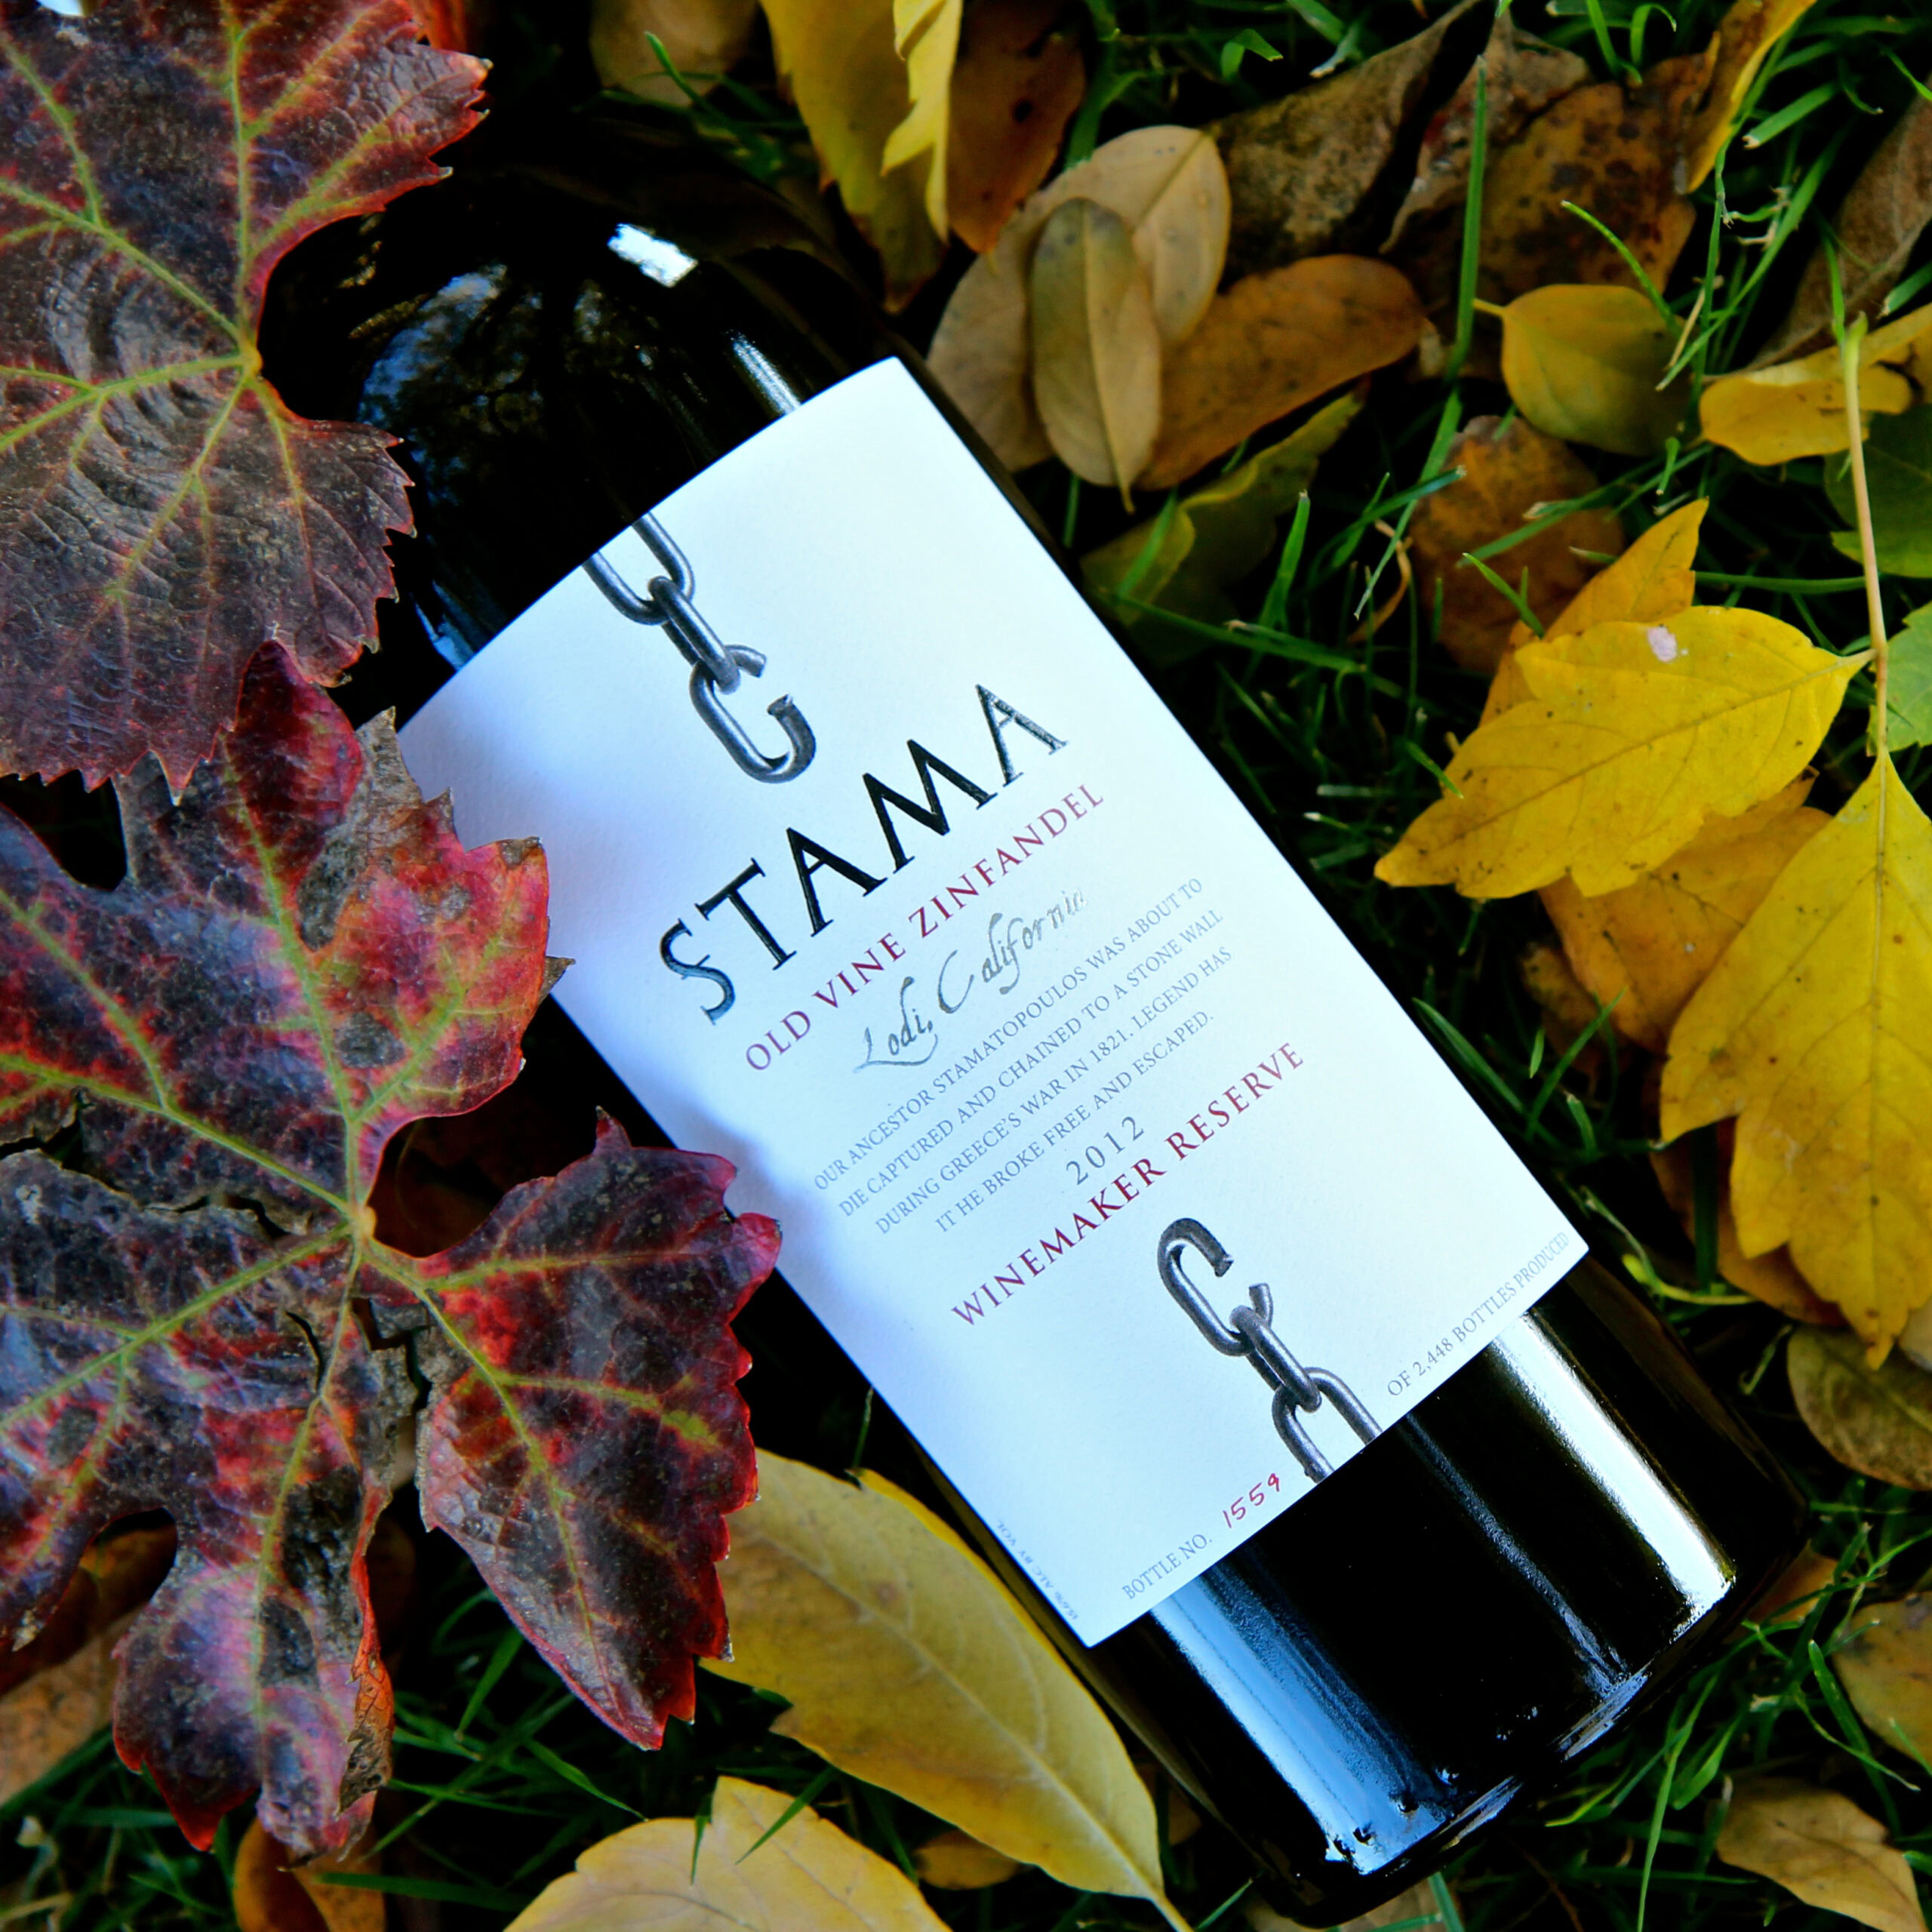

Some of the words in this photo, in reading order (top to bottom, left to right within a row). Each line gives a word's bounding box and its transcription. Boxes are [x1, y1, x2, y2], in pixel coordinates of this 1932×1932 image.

[660, 684, 1069, 1026] STAMA
[746, 1009, 811, 1071] OLD
[811, 932, 906, 1009] VINE
[908, 783, 1104, 938] ZINFANDEL
[853, 976, 938, 1074] Lodi,
[937, 888, 1088, 1014] California
[814, 1159, 849, 1190] OUR
[848, 1089, 935, 1164] ANCESTOR
[933, 966, 1088, 1094] STAMATOPOULOS
[1086, 937, 1126, 971] WAS
[1128, 893, 1180, 943] ABOUT
[1178, 878, 1202, 900] TO
[838, 1189, 869, 1217] DIE
[866, 1119, 953, 1194] CAPTURED
[956, 1085, 996, 1124] AND
[998, 1017, 1081, 1088] CHAINED
[1081, 995, 1110, 1021] TO
[1113, 984, 1128, 1000] A
[1126, 939, 1183, 988] STONE
[1180, 909, 1223, 945] WALL
[875, 1177, 940, 1235] DURING
[940, 1112, 1021, 1182] GREECE'S
[1020, 1078, 1067, 1116] WAR
[1063, 1058, 1089, 1084] IN
[1090, 1029, 1134, 1063] 1821.
[1131, 971, 1199, 1030] LEGEND
[1198, 946, 1232, 978] HAS
[935, 1210, 956, 1232] IT
[955, 1189, 984, 1217] HE
[982, 1141, 1044, 1195] BROKE
[1043, 1104, 1091, 1146] FREE
[1092, 1071, 1132, 1110] AND
[1132, 1010, 1214, 1075] ESCAPED.
[1065, 1116, 1144, 1186] 2012
[950, 1158, 1168, 1326] WINEMAKER
[1164, 1042, 1305, 1161] RESERVE
[1121, 1552, 1182, 1599] BOTTLE
[1178, 1534, 1212, 1560] NO.
[1223, 1473, 1279, 1529] 1559
[1387, 1371, 1413, 1396] OF
[1413, 1337, 1454, 1377] 2,448
[1451, 1281, 1517, 1343] BOTTLES
[1512, 1232, 1570, 1289] PRODUCED
